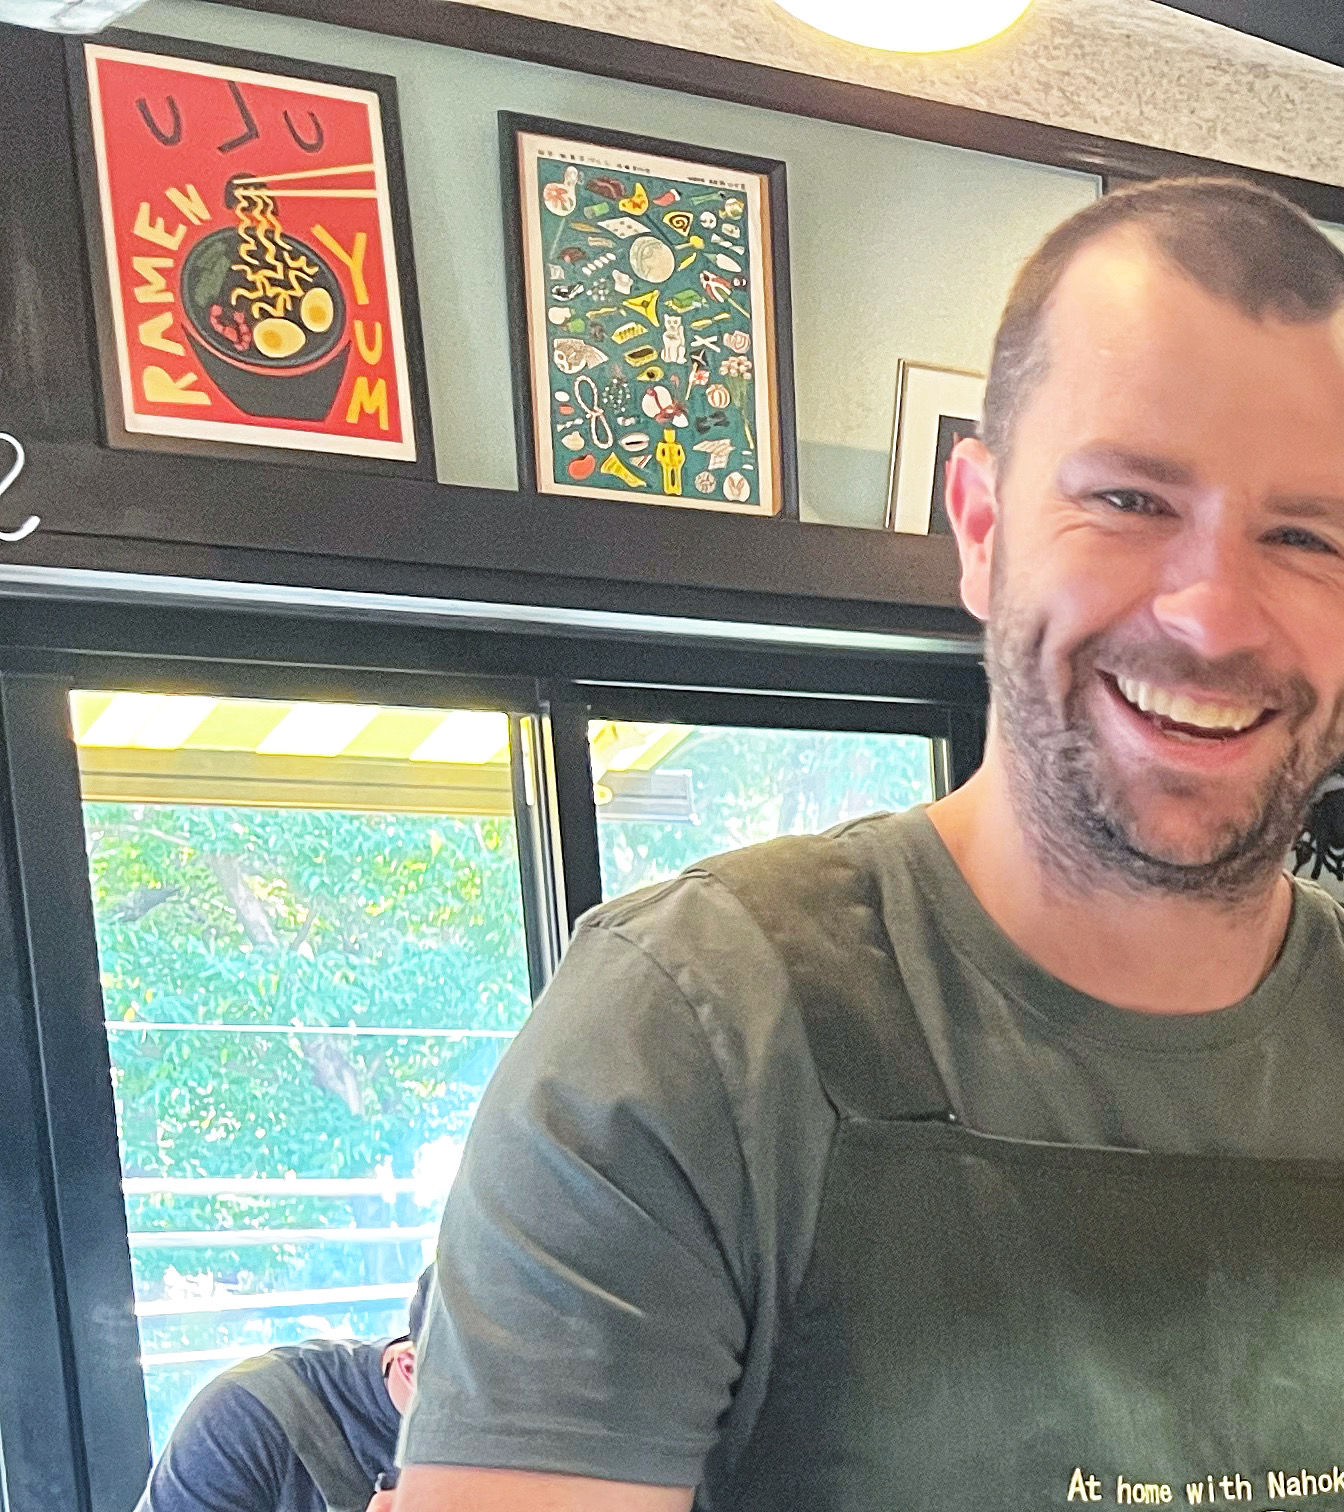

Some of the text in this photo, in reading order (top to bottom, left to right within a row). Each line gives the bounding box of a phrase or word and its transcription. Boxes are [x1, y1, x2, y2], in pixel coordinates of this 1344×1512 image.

[131, 182, 213, 406] RAMEN
[310, 223, 390, 431] YUM
[1067, 1467, 1102, 1502] At
[1117, 1474, 1173, 1505] home
[1185, 1473, 1253, 1506] with
